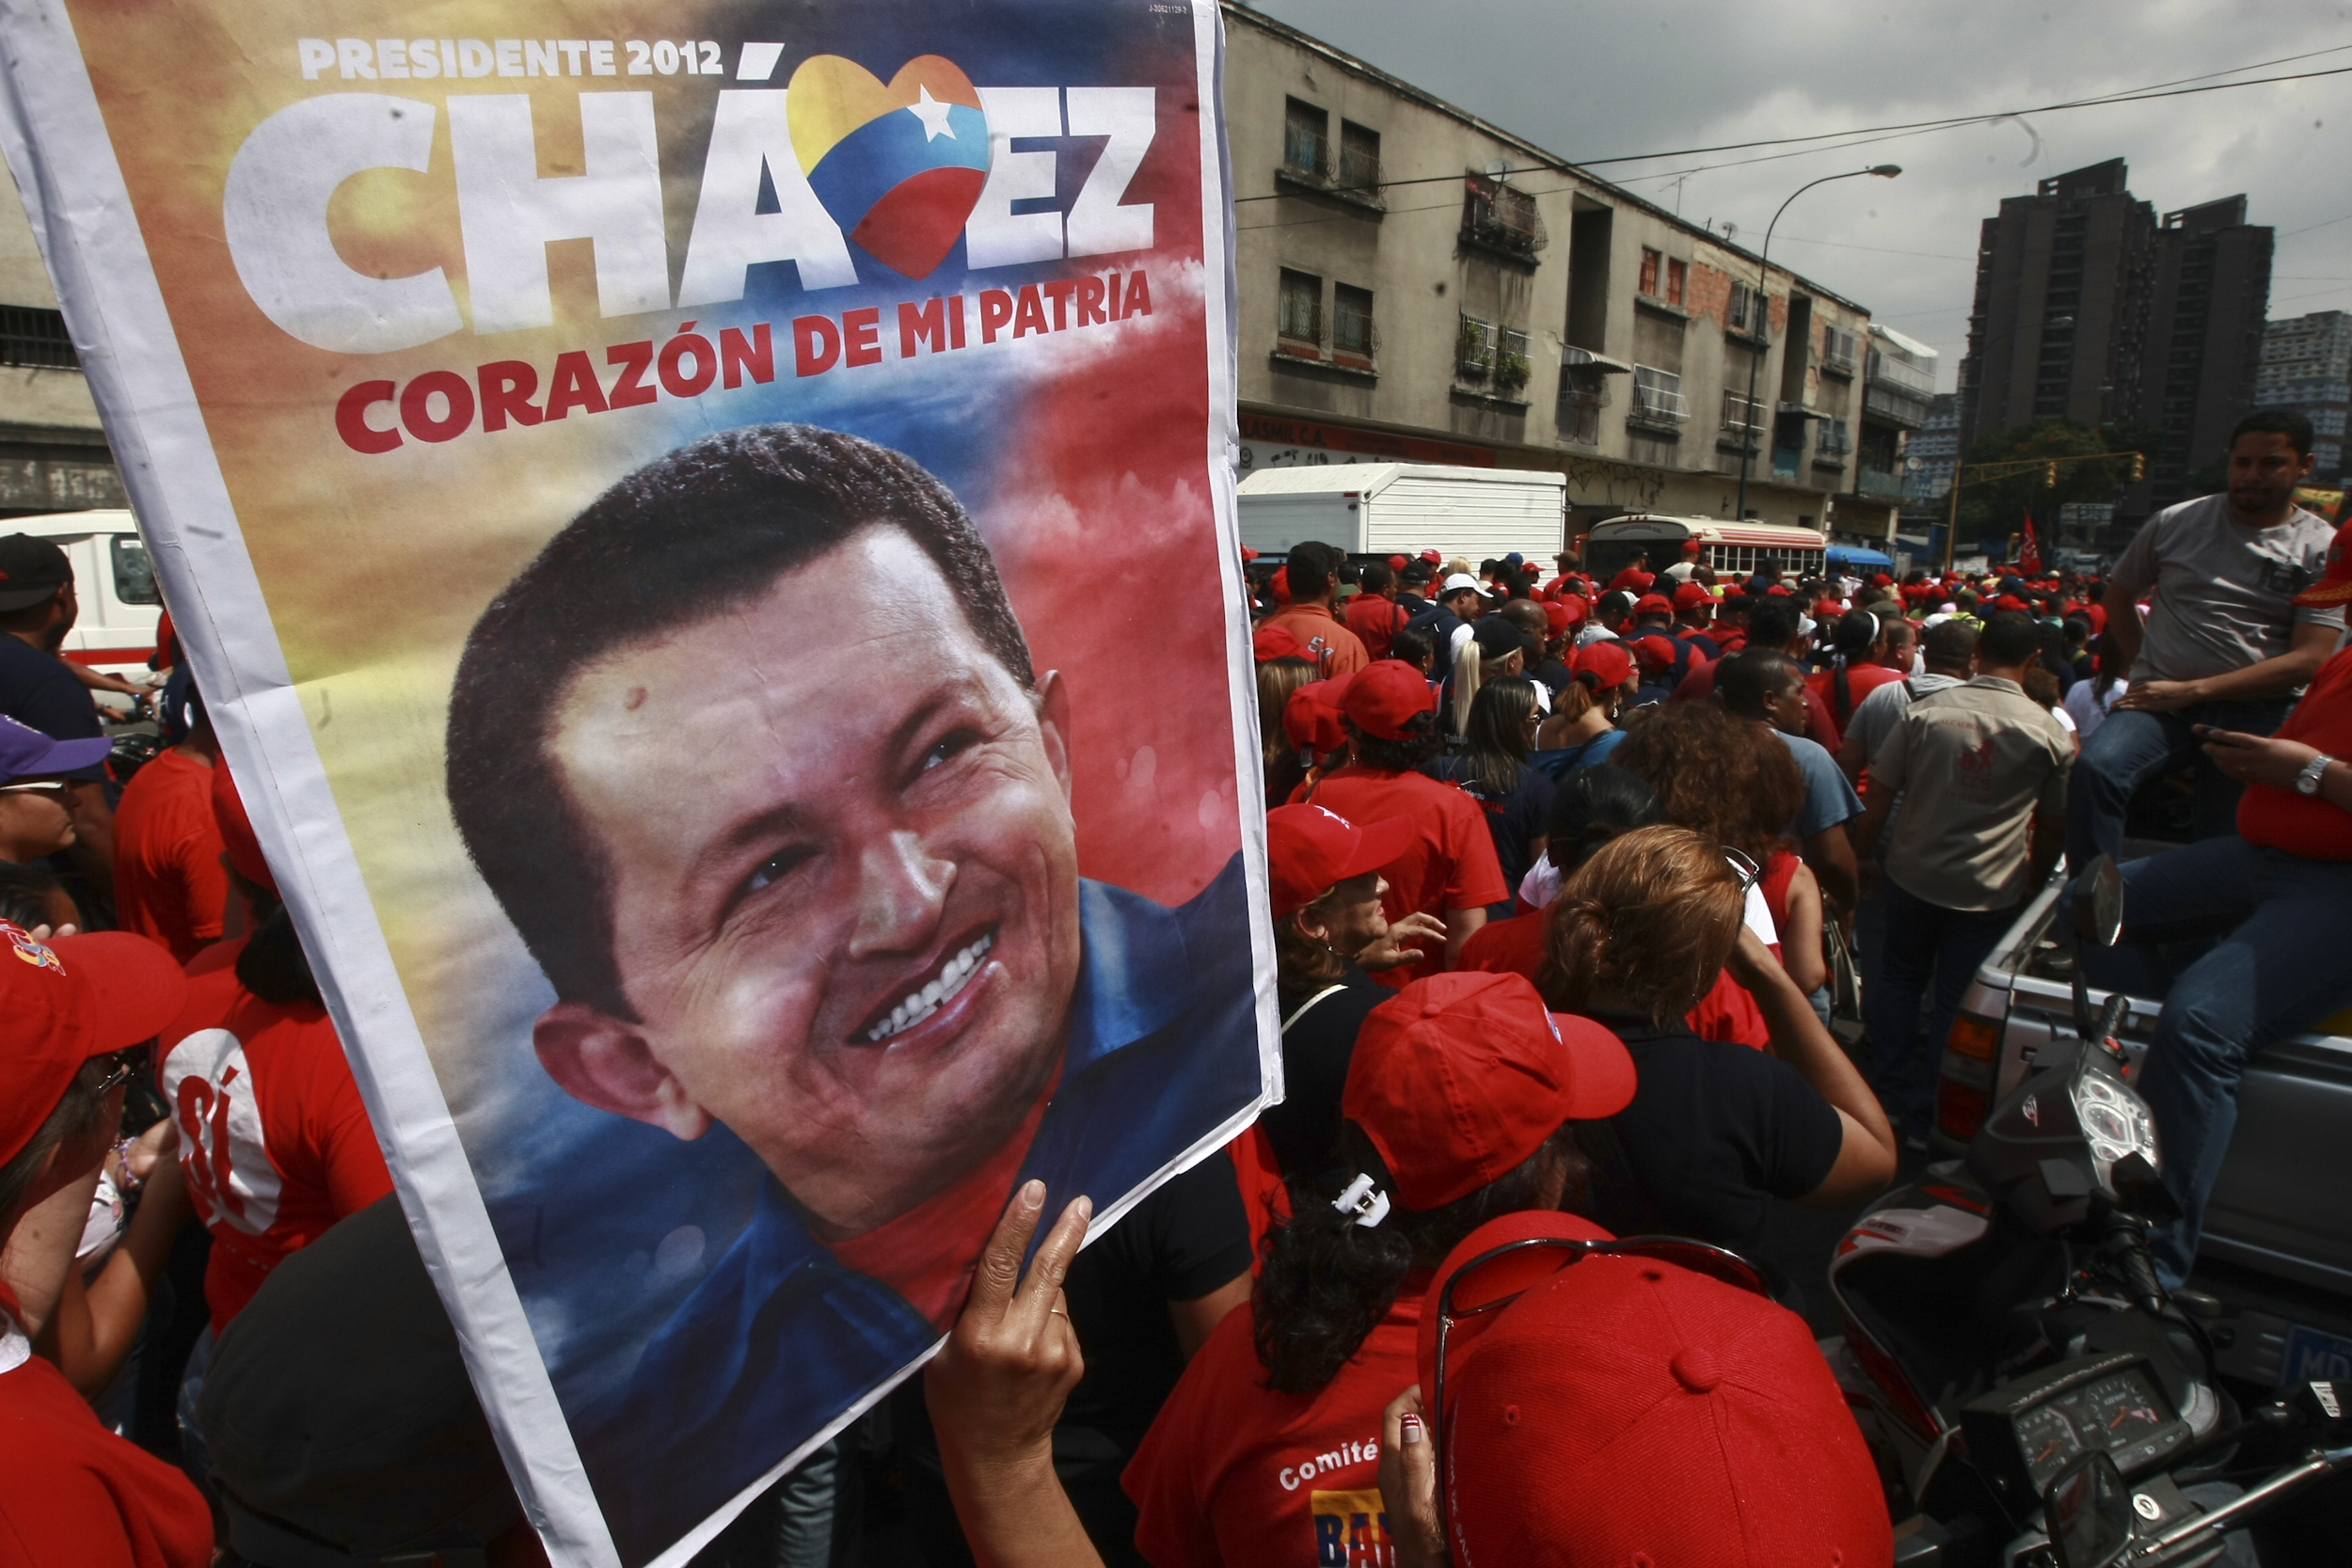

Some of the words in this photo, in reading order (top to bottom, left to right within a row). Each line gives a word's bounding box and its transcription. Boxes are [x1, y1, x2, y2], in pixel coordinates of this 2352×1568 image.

[297, 38, 617, 80] PRESIDENTE
[626, 40, 723, 75] 2012
[335, 321, 775, 454] CORAZÓN
[792, 307, 882, 378] DE
[898, 295, 966, 359] MI
[979, 270, 1152, 344] PATRIA
[1240, 419, 1294, 443] LASMIL
[1279, 1437, 1378, 1491] Comité
